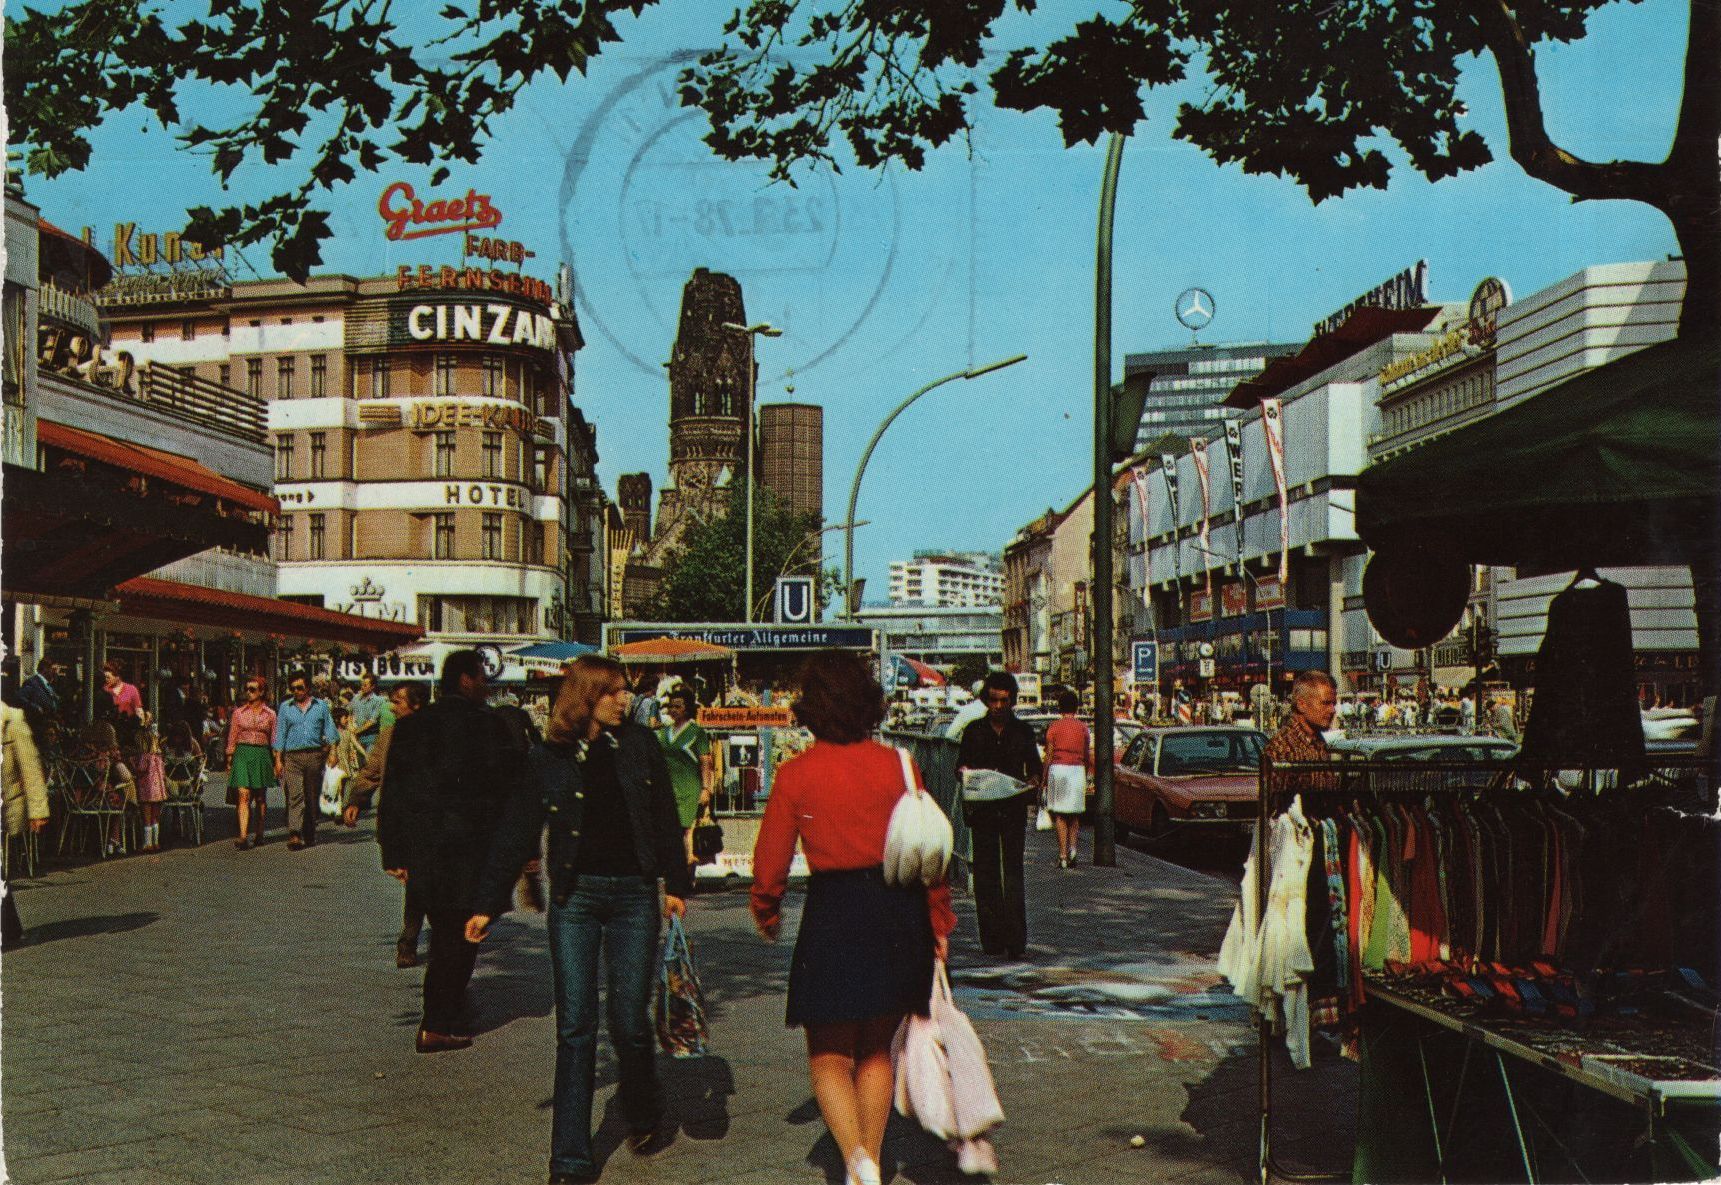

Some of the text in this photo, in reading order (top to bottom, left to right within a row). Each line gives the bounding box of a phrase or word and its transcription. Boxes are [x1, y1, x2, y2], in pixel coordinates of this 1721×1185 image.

[378, 182, 503, 241] Graetz
[465, 235, 536, 265] FARB-
[444, 484, 524, 508] HOTEL
[783, 584, 808, 621] U
[750, 630, 829, 650] Allgemeine
[1138, 647, 1152, 667] P
[1380, 652, 1391, 669] U
